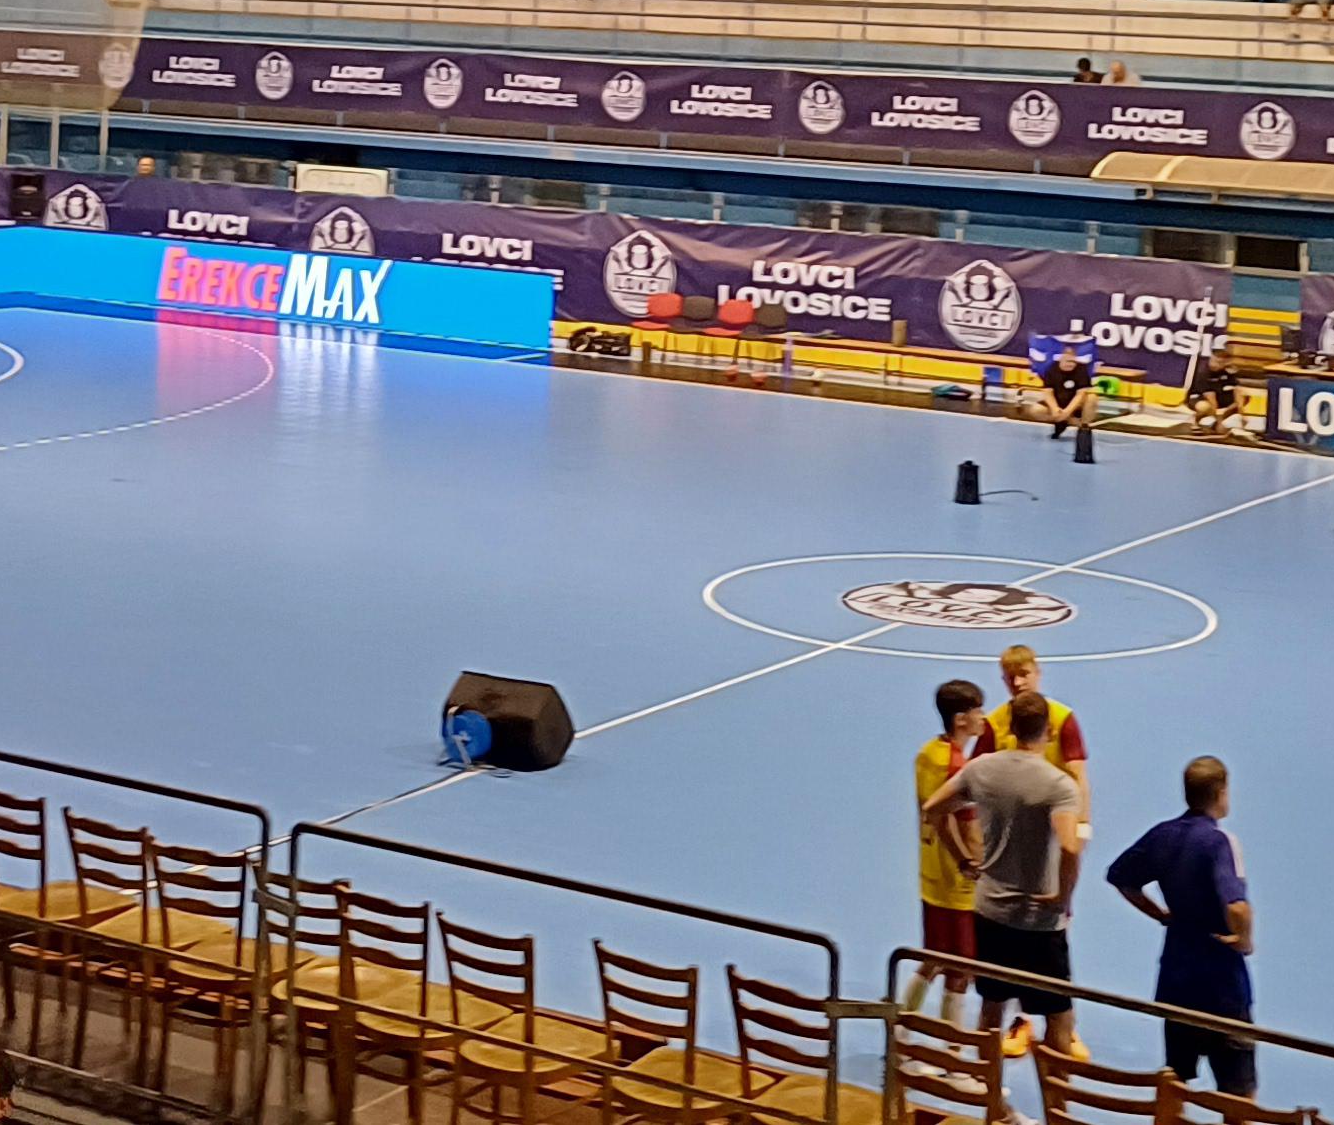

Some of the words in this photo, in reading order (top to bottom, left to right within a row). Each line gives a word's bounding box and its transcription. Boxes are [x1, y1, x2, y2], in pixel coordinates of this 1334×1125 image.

[690, 84, 752, 101] LOVCI
[893, 95, 958, 112] LOVCI
[871, 112, 981, 132] LOVOSICE
[1112, 107, 1184, 125] LOVCI
[1087, 123, 1208, 145] LOVOSICE
[167, 209, 249, 236] LOVCI
[441, 233, 533, 261] LOVCI
[752, 259, 855, 290] LOVCI
[1110, 292, 1228, 328] LOVCI
